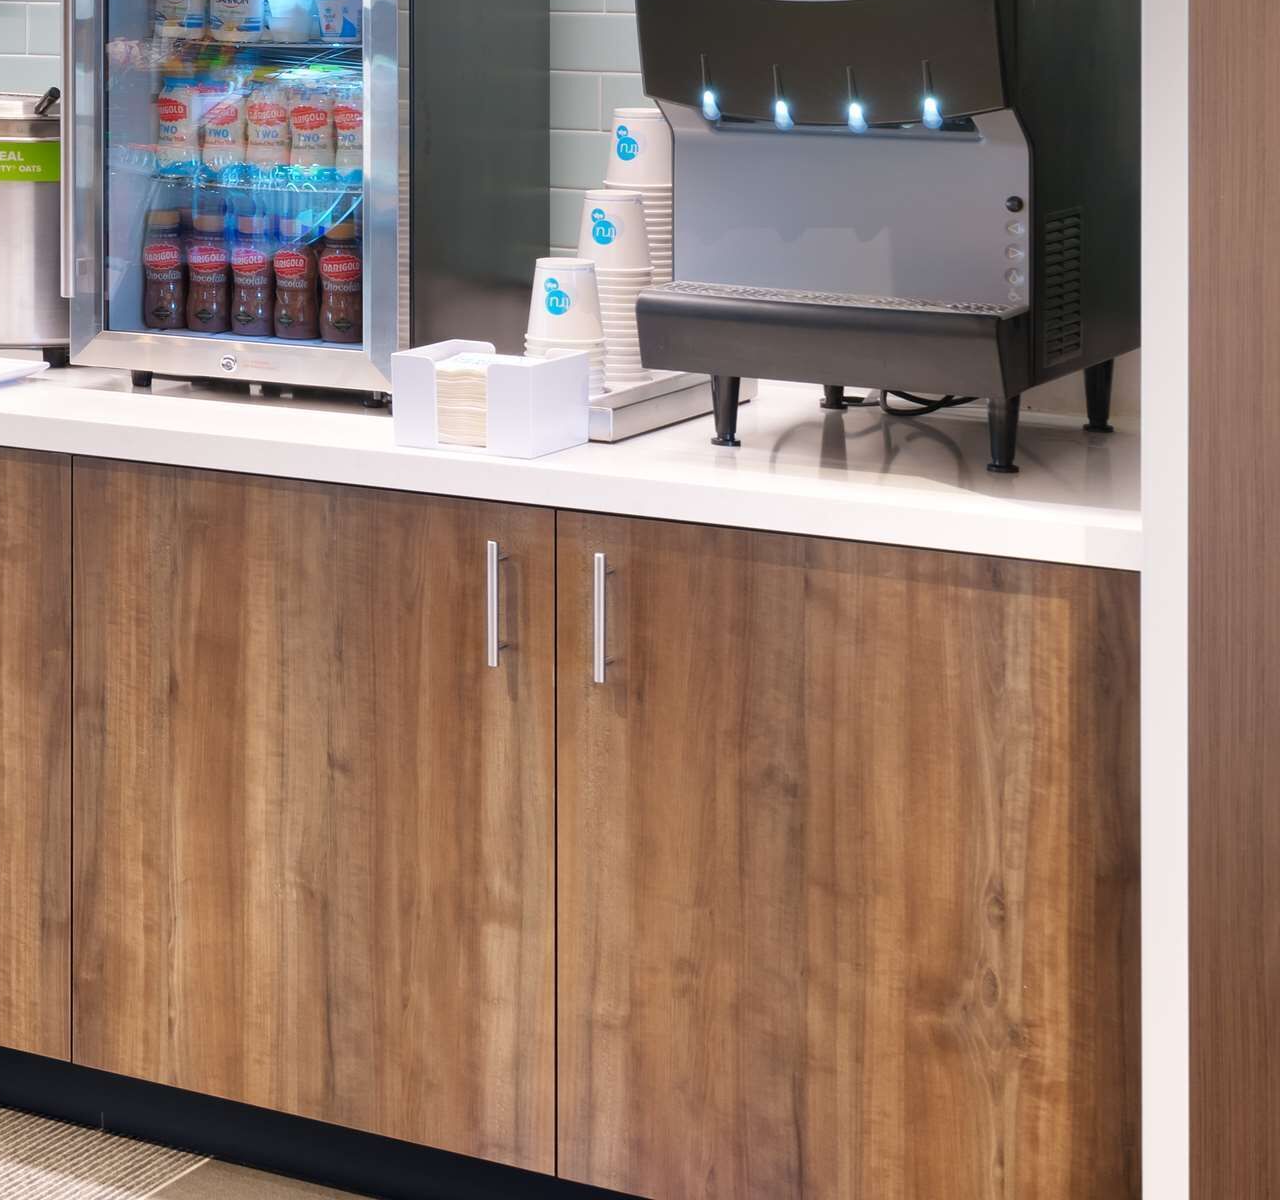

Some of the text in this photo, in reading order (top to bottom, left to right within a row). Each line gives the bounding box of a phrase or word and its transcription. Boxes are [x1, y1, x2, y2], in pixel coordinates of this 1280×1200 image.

[208, 128, 229, 138] TWO
[256, 129, 279, 139] TWO
[297, 133, 320, 143] TWO
[18, 165, 42, 173] OATS
[322, 262, 360, 272] DARIGOLD
